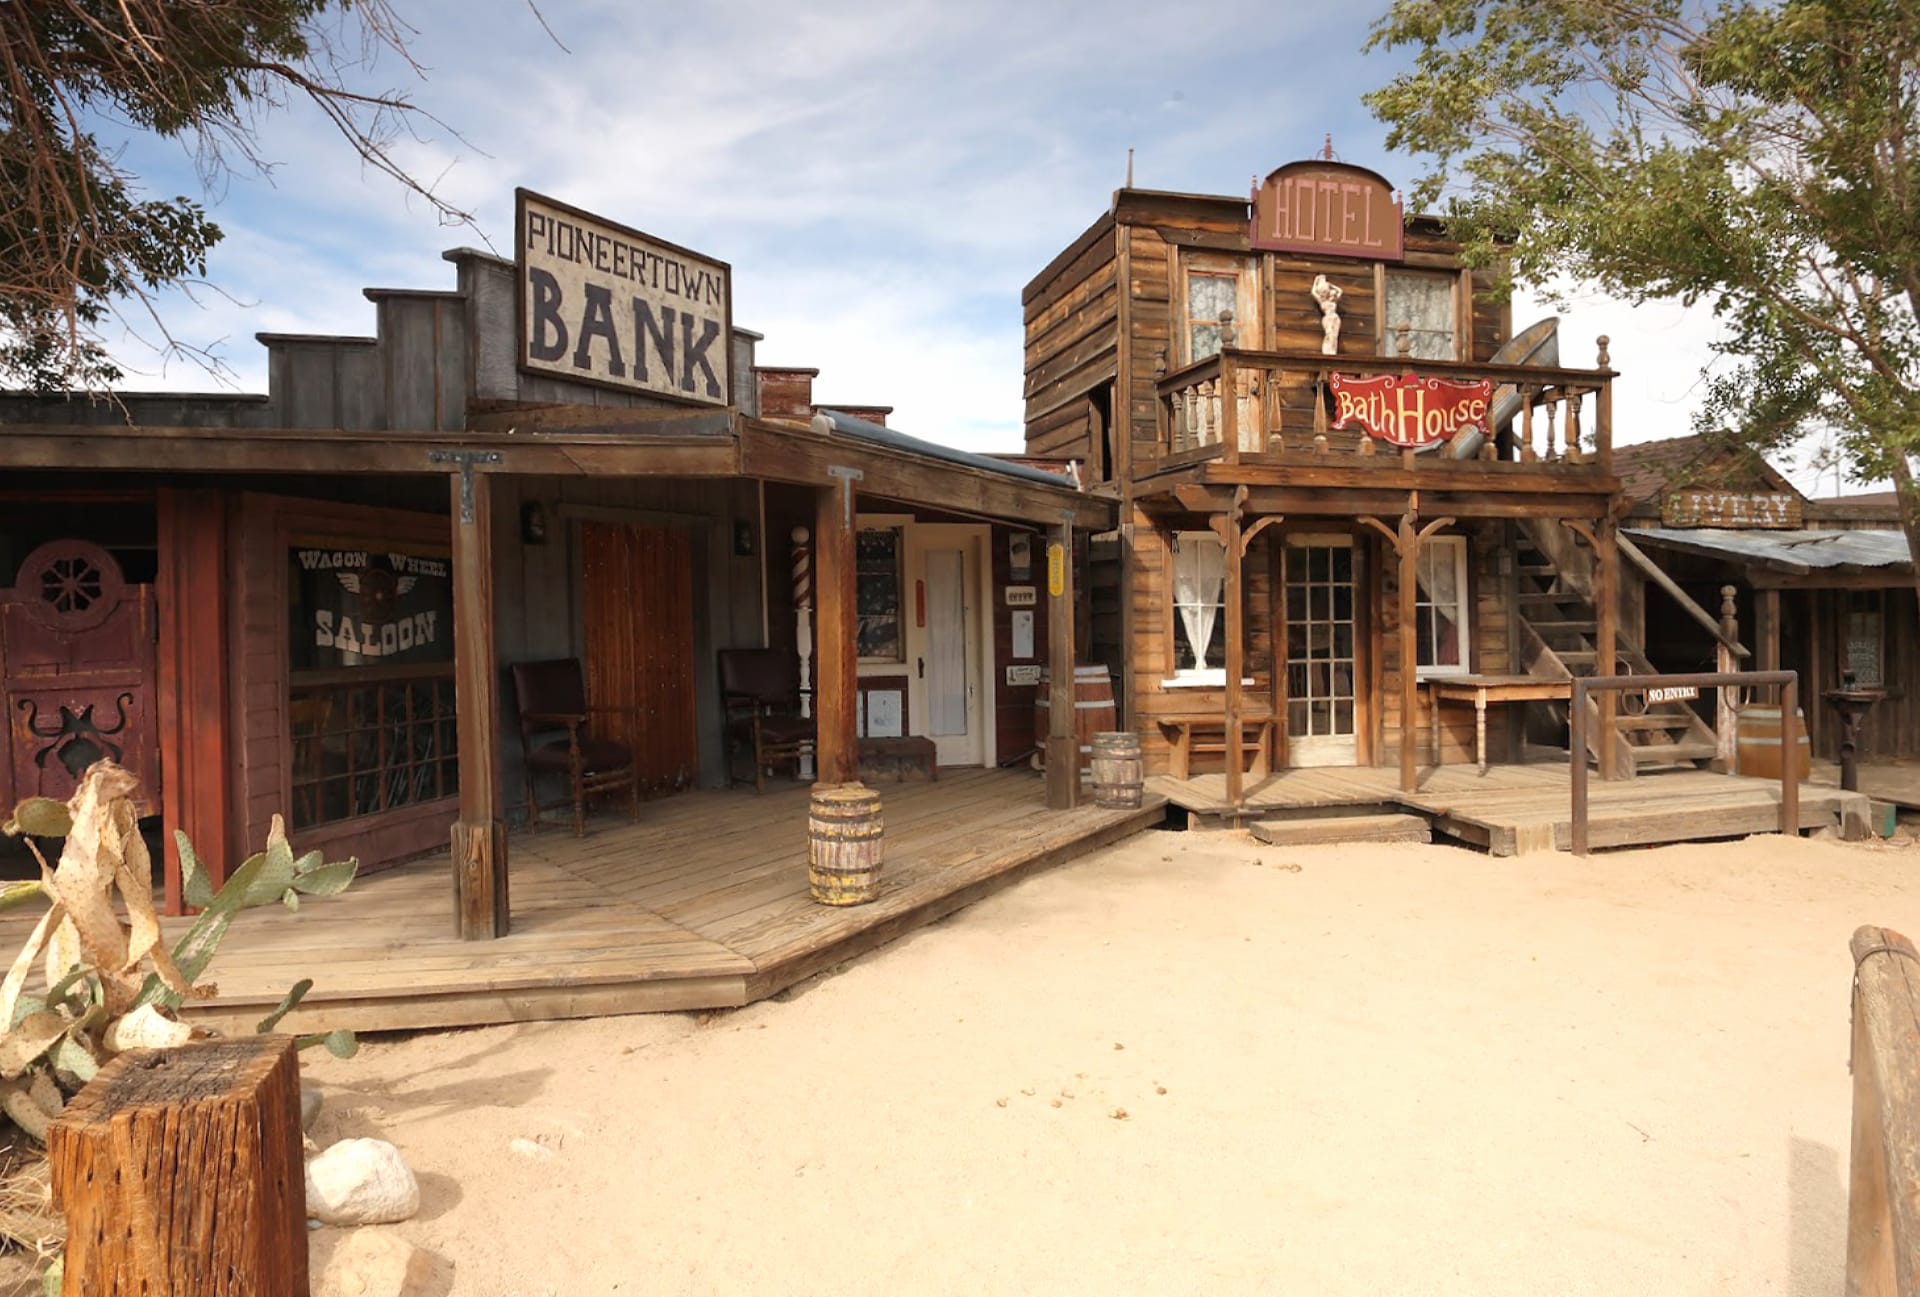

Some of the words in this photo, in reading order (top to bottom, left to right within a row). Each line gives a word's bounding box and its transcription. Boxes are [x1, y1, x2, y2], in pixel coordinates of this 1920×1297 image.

[1272, 177, 1382, 246] HOTEL
[528, 210, 721, 305] PIONEERTOWN
[529, 266, 721, 398] BANK
[299, 551, 368, 569] WAGON
[388, 553, 447, 577] WHEEL
[316, 609, 436, 656] SALOON
[1648, 689, 1663, 702] NO
